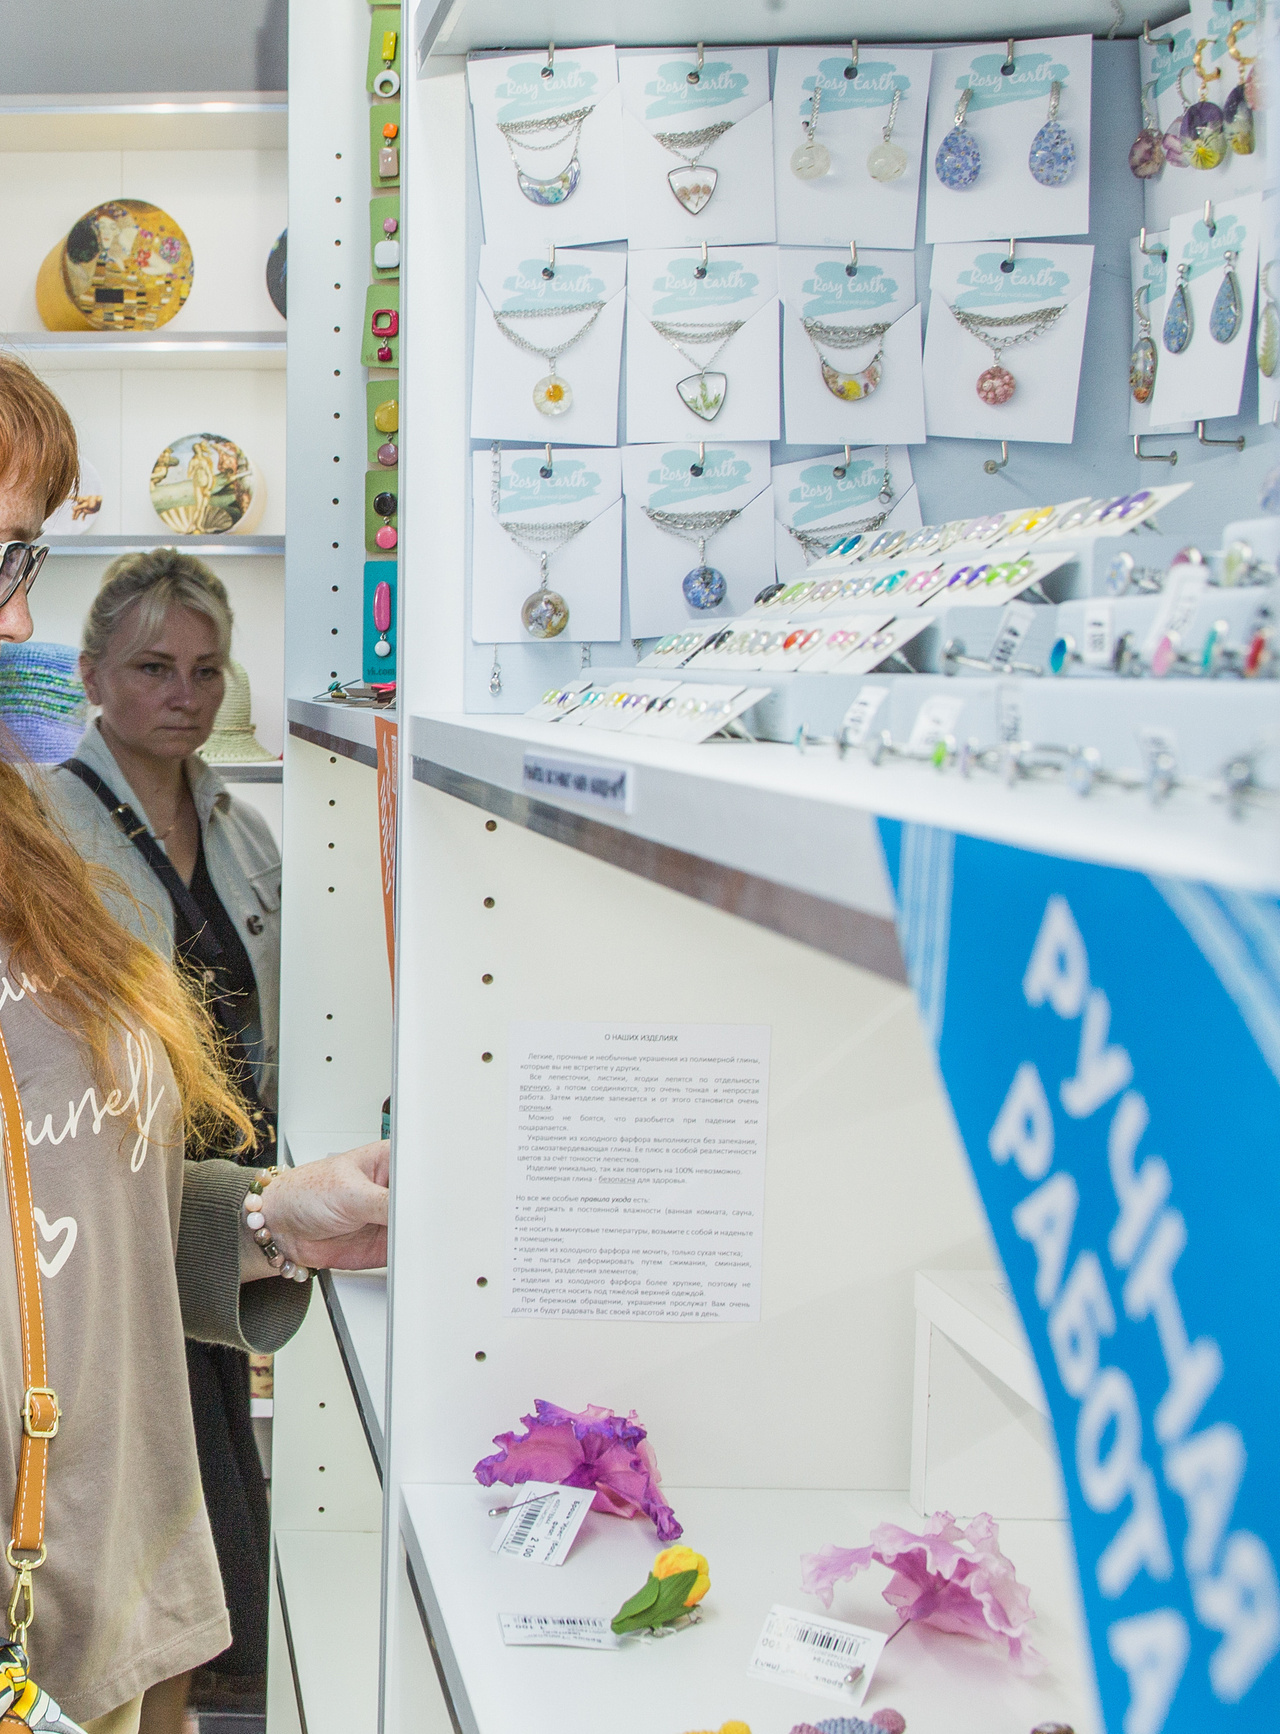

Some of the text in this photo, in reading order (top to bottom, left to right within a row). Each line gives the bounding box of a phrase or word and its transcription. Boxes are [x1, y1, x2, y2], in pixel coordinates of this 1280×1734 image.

[968, 61, 1056, 92] Rosy Earth
[507, 71, 586, 100] Rosy Earth
[656, 78, 689, 99] Rosy
[815, 72, 898, 98] Rosy Earth
[665, 271, 747, 296] Rosy Earth
[970, 267, 1057, 292] Rosy Earth
[515, 273, 594, 298] Rosy Earth
[812, 274, 888, 299] Rosy Earth
[660, 459, 740, 487] Rosy arth
[510, 470, 542, 495] Rosy
[800, 481, 832, 502] Rosy
[836, 469, 880, 491] Earth
[604, 1033, 679, 1042] О НАШИХ ИЗДЕЛИЯХ
[556, 1054, 588, 1062] прочные
[638, 1056, 678, 1064] украшения
[689, 1055, 736, 1065] полимерной
[520, 1064, 550, 1072] которые
[573, 1065, 609, 1073] встретите
[634, 1076, 659, 1084] ягодки
[714, 1078, 760, 1086] отдельности
[722, 1088, 760, 1096] непростая
[550, 1093, 571, 1101] Затем
[574, 1095, 605, 1103] изделие
[528, 1113, 555, 1121] Можно
[704, 1118, 736, 1126] падении
[527, 1133, 567, 1143] Украшения
[579, 1136, 618, 1144] холодного
[619, 1135, 652, 1145] фарфора
[530, 1146, 609, 1154] самозатвердевающая
[671, 1146, 698, 1154] особой
[699, 1149, 757, 1157] реалистичности
[516, 1155, 542, 1163] цветов
[526, 1164, 558, 1173] Изделие
[625, 1167, 663, 1175] повторить
[526, 1174, 571, 1184] Полимерная
[598, 1175, 636, 1183] безопасна
[552, 1194, 632, 1205] особые правила ухода
[534, 1206, 566, 1214] держать
[577, 1205, 620, 1213] постоянной
[664, 1207, 693, 1217] (ванная
[560, 1227, 600, 1235] минусовые
[690, 1228, 713, 1236] собой
[720, 1230, 754, 1238] наденьте
[518, 1247, 549, 1255] изделия
[559, 1247, 598, 1256] холодного
[598, 1247, 630, 1256] фарфора
[577, 1257, 635, 1266] деформировать
[554, 1268, 597, 1276] разделения
[520, 1277, 550, 1286] изделия
[568, 1278, 606, 1287] холодного
[609, 1278, 642, 1287] фарфора
[707, 1281, 738, 1289] поэтому
[512, 1287, 567, 1296] рекомендуется
[640, 1288, 670, 1298] верхней
[539, 1296, 577, 1306] бережном
[626, 1300, 667, 1308] украшения
[669, 1300, 708, 1309] прослужат
[1024, 893, 1280, 1706] РУЧНАЯ
[561, 1308, 665, 1318] радовать красотой
